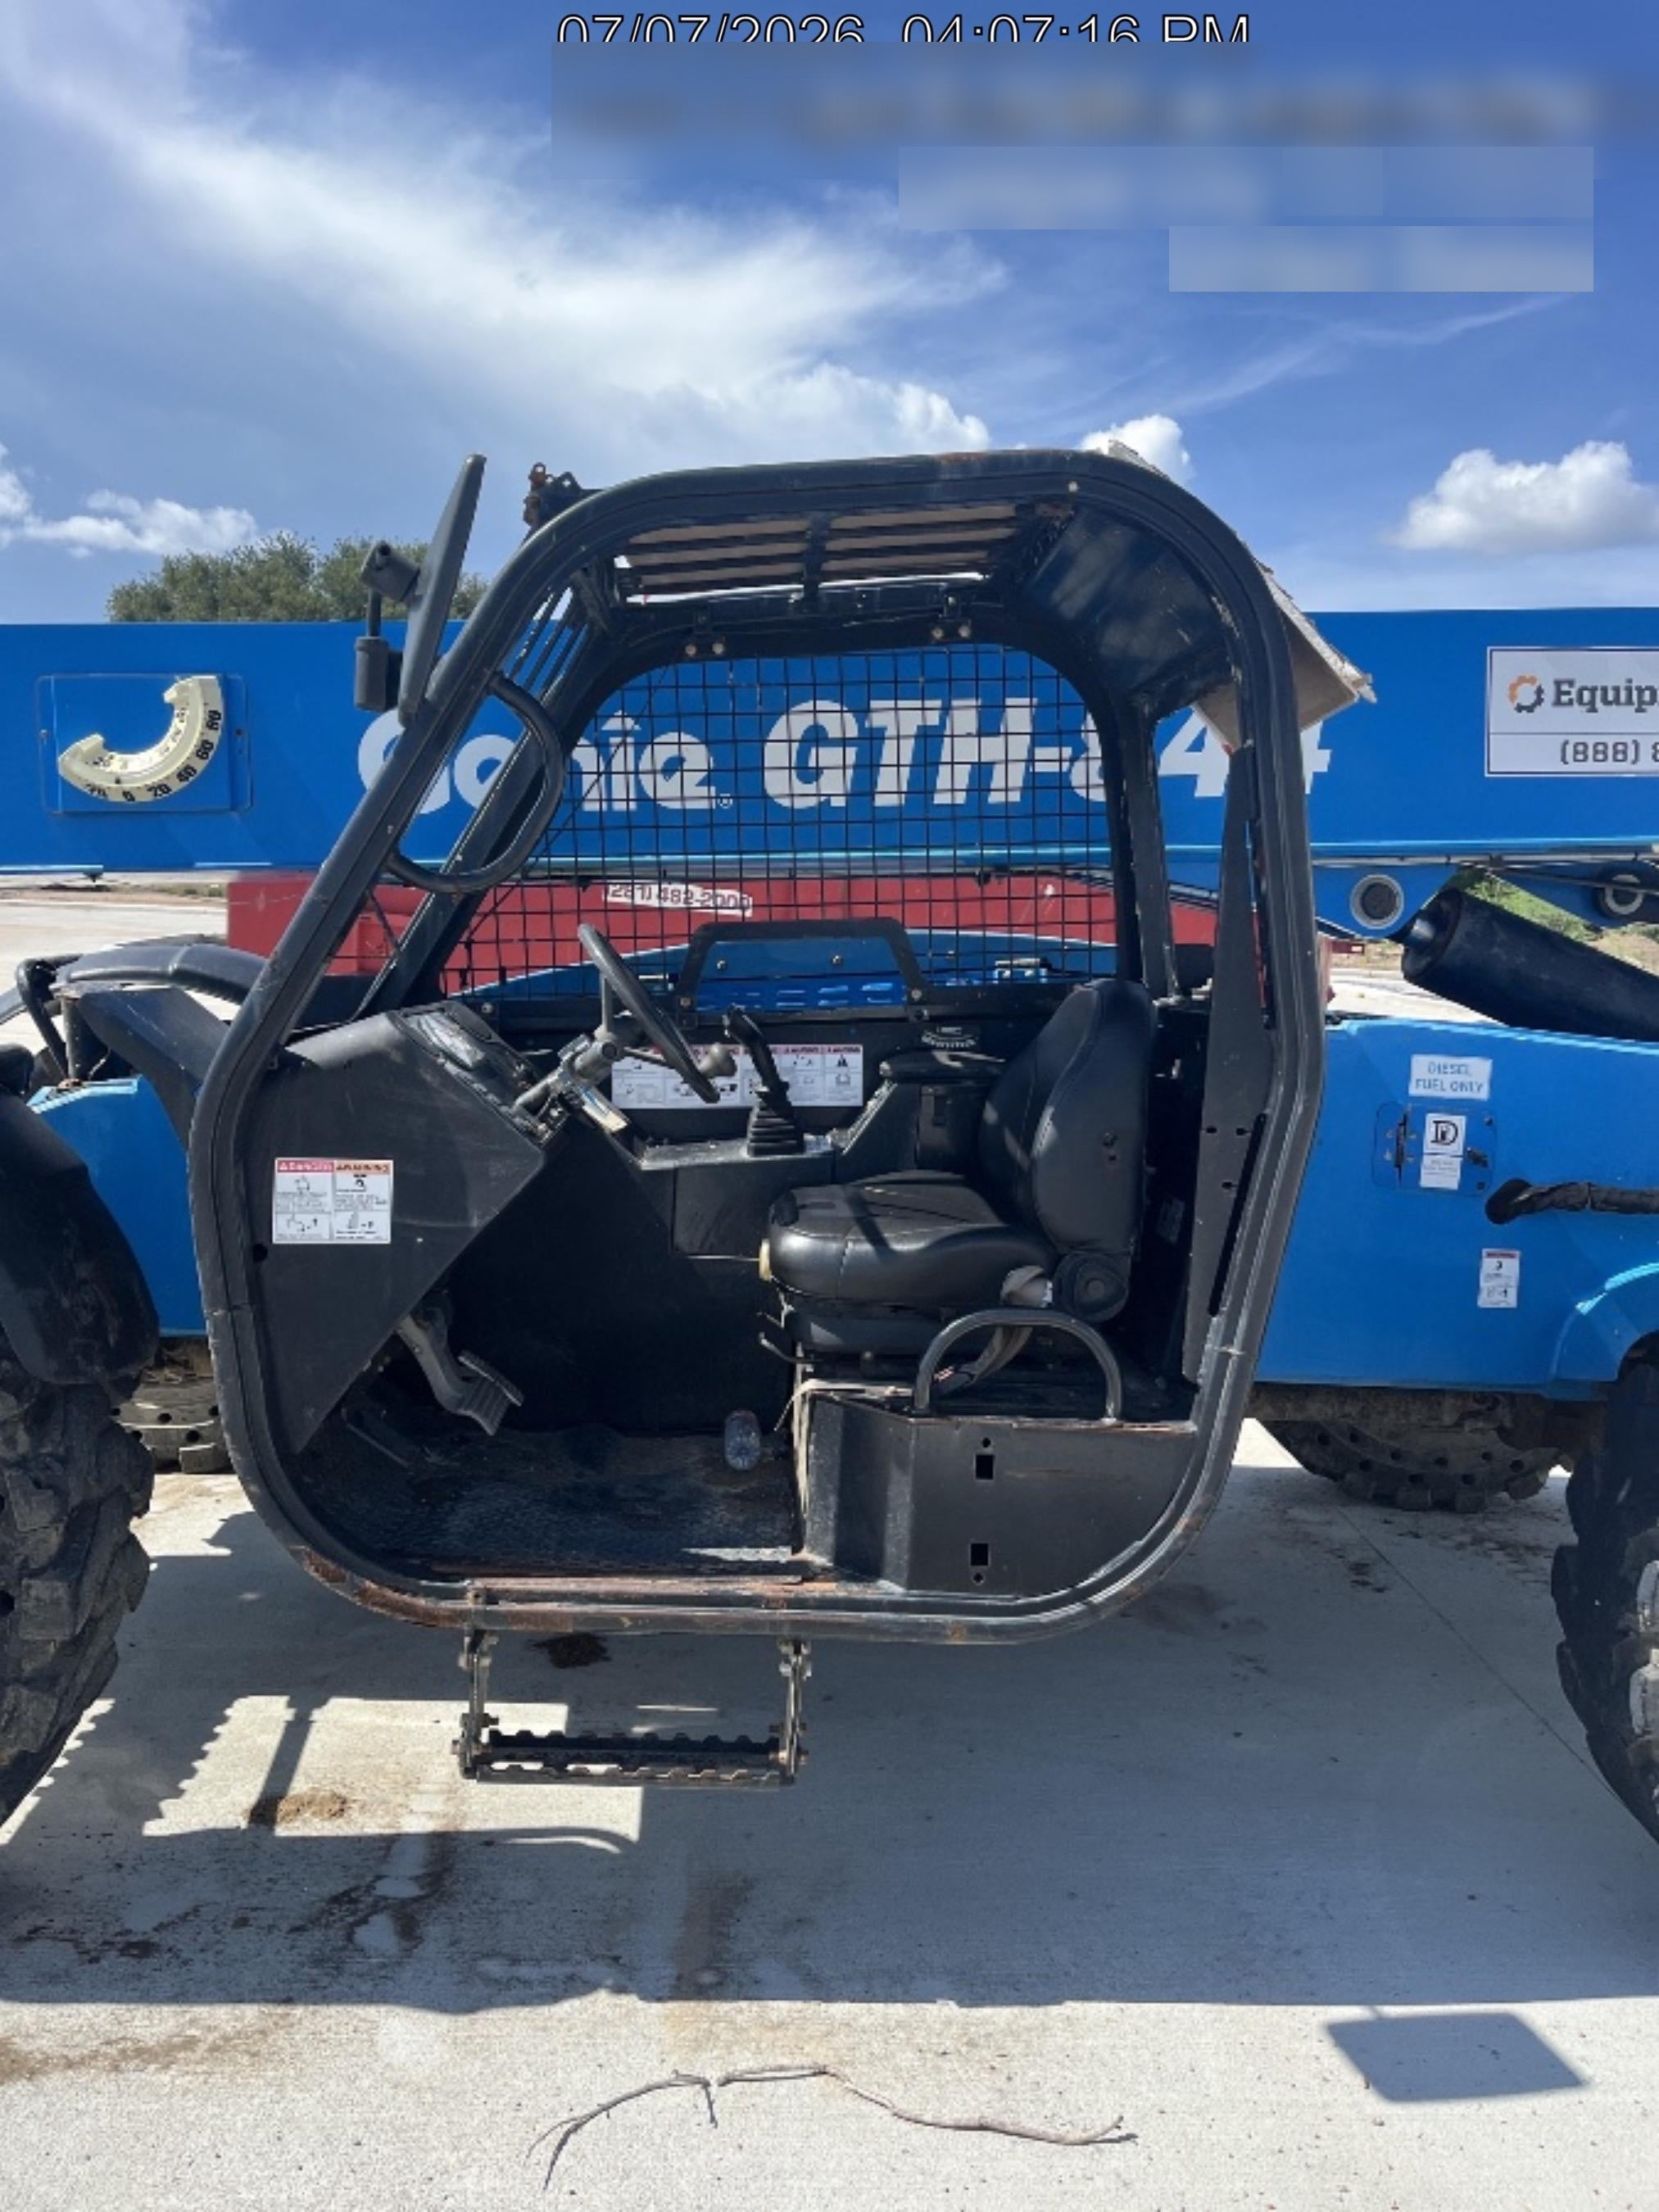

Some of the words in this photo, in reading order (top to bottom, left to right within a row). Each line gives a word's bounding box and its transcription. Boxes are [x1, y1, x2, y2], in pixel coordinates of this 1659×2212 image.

[1561, 740, 1640, 764] (888)
[1415, 1078, 1447, 1092] FUEL
[1449, 1081, 1484, 1093] ONLY
